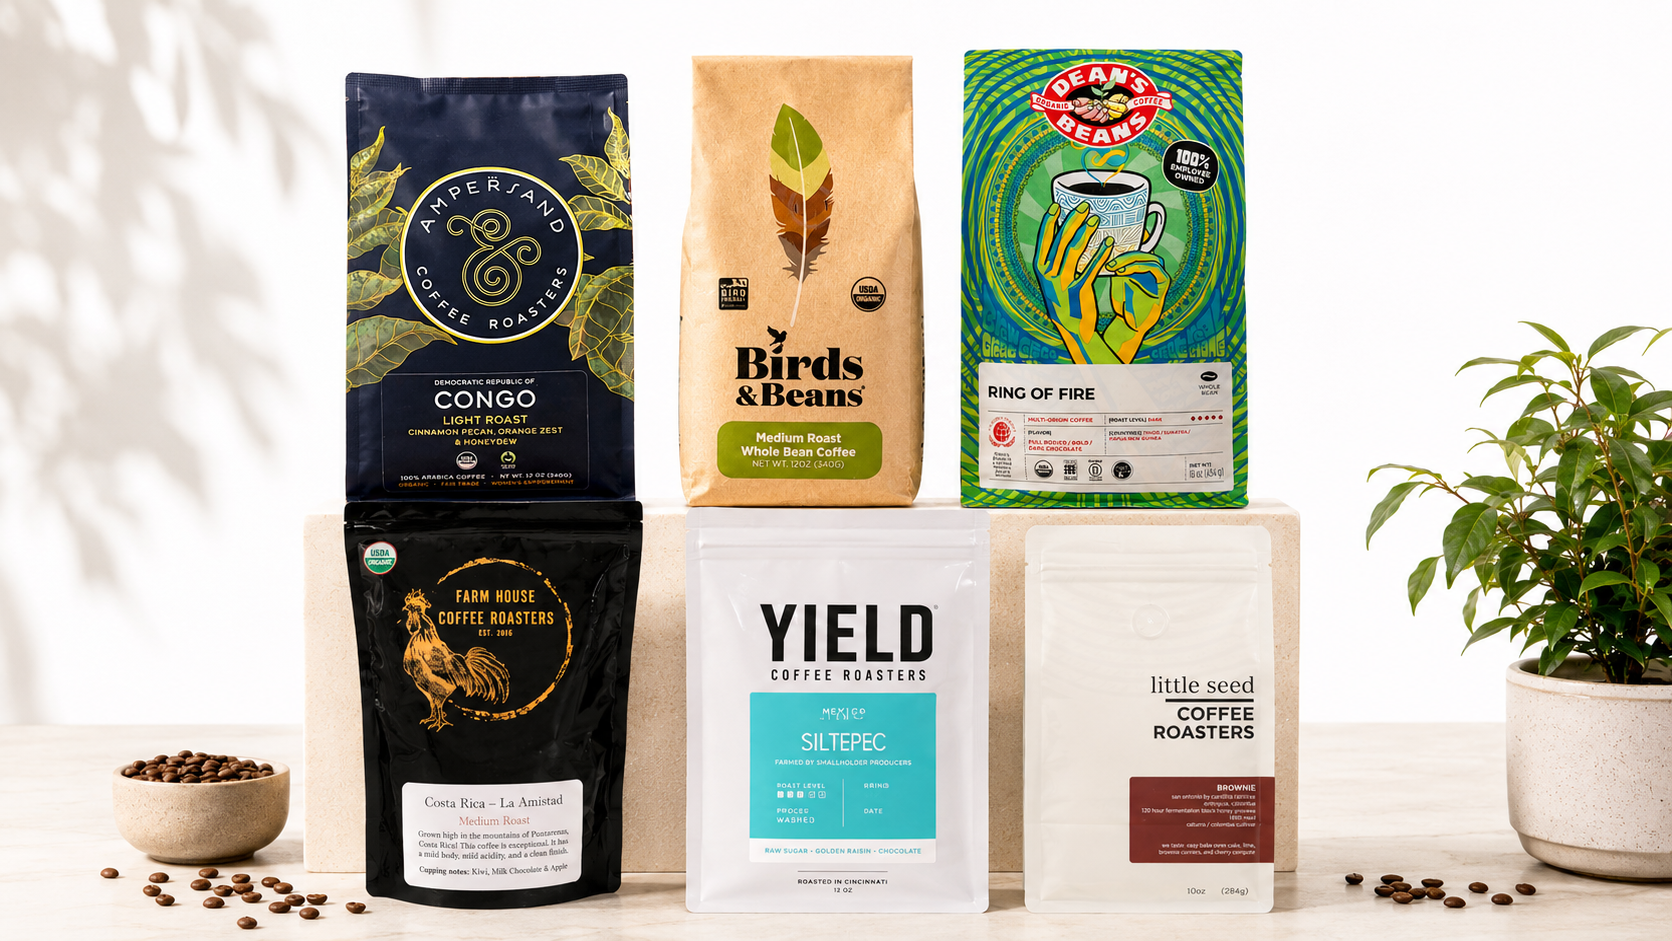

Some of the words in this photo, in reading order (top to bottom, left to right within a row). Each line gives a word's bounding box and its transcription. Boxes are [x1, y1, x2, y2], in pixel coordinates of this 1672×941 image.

[1051, 67, 1149, 97] DEAN'S
[1056, 112, 1147, 143] BEANS
[1177, 149, 1210, 169] 100%
[1171, 164, 1211, 178] EMPLOYEE
[1175, 172, 1204, 184] OWNED
[417, 266, 470, 325] COFFEE
[489, 267, 567, 329] ROASTERS
[735, 346, 864, 380] Birds
[435, 389, 536, 409] CONGO
[988, 386, 1026, 400] RING
[1031, 387, 1053, 400] OF
[1059, 387, 1095, 400] FIRE
[443, 415, 481, 426] LIGHT
[485, 415, 528, 425] ROAST
[408, 428, 459, 436] CINNAMON
[462, 428, 495, 436] PECAN,
[498, 427, 537, 435] ORANGE
[756, 432, 804, 443] Medium
[808, 433, 841, 444] Roast
[741, 446, 779, 457] Whole
[783, 446, 813, 457] Bean
[817, 446, 856, 458] Coffee
[752, 460, 769, 468] NET
[772, 460, 789, 468] WT.
[456, 590, 489, 603] FARM
[496, 590, 535, 603] HOUSE
[438, 611, 484, 625] COFFEE
[490, 611, 554, 625] ROASTERS
[479, 629, 494, 637] EST.
[497, 629, 513, 637] 2016
[760, 604, 933, 662] YIELD
[771, 669, 832, 681] COFFEE
[843, 669, 926, 681] ROASTERS
[1151, 676, 1200, 694] little
[1207, 676, 1254, 694] seed
[1177, 707, 1254, 721] COFFEE
[1154, 725, 1254, 739] ROASTERS
[801, 732, 886, 752] SILTEPEC
[425, 796, 456, 808] Costa
[460, 797, 485, 808] Rica
[500, 797, 515, 808] La
[518, 794, 563, 807] Amistad
[459, 816, 499, 826] Medium
[503, 815, 530, 825] Roast
[777, 816, 815, 824] WASHED
[418, 830, 440, 838] Grown
[443, 831, 458, 841] high
[461, 831, 468, 839] in
[522, 830, 529, 838] of
[419, 840, 438, 849] Costa
[460, 842, 475, 850] This
[477, 841, 499, 849] coffee
[424, 851, 439, 859] mild
[441, 851, 460, 860] body,
[508, 851, 522, 859] and
[530, 849, 547, 858] clean
[419, 866, 446, 876] Cupping
[448, 867, 469, 876] notes:
[471, 868, 490, 876] Kiwi,
[492, 867, 508, 875] Milk
[509, 865, 542, 875] Chocolate
[550, 863, 568, 872] Apple
[1221, 887, 1248, 896] (284g)
